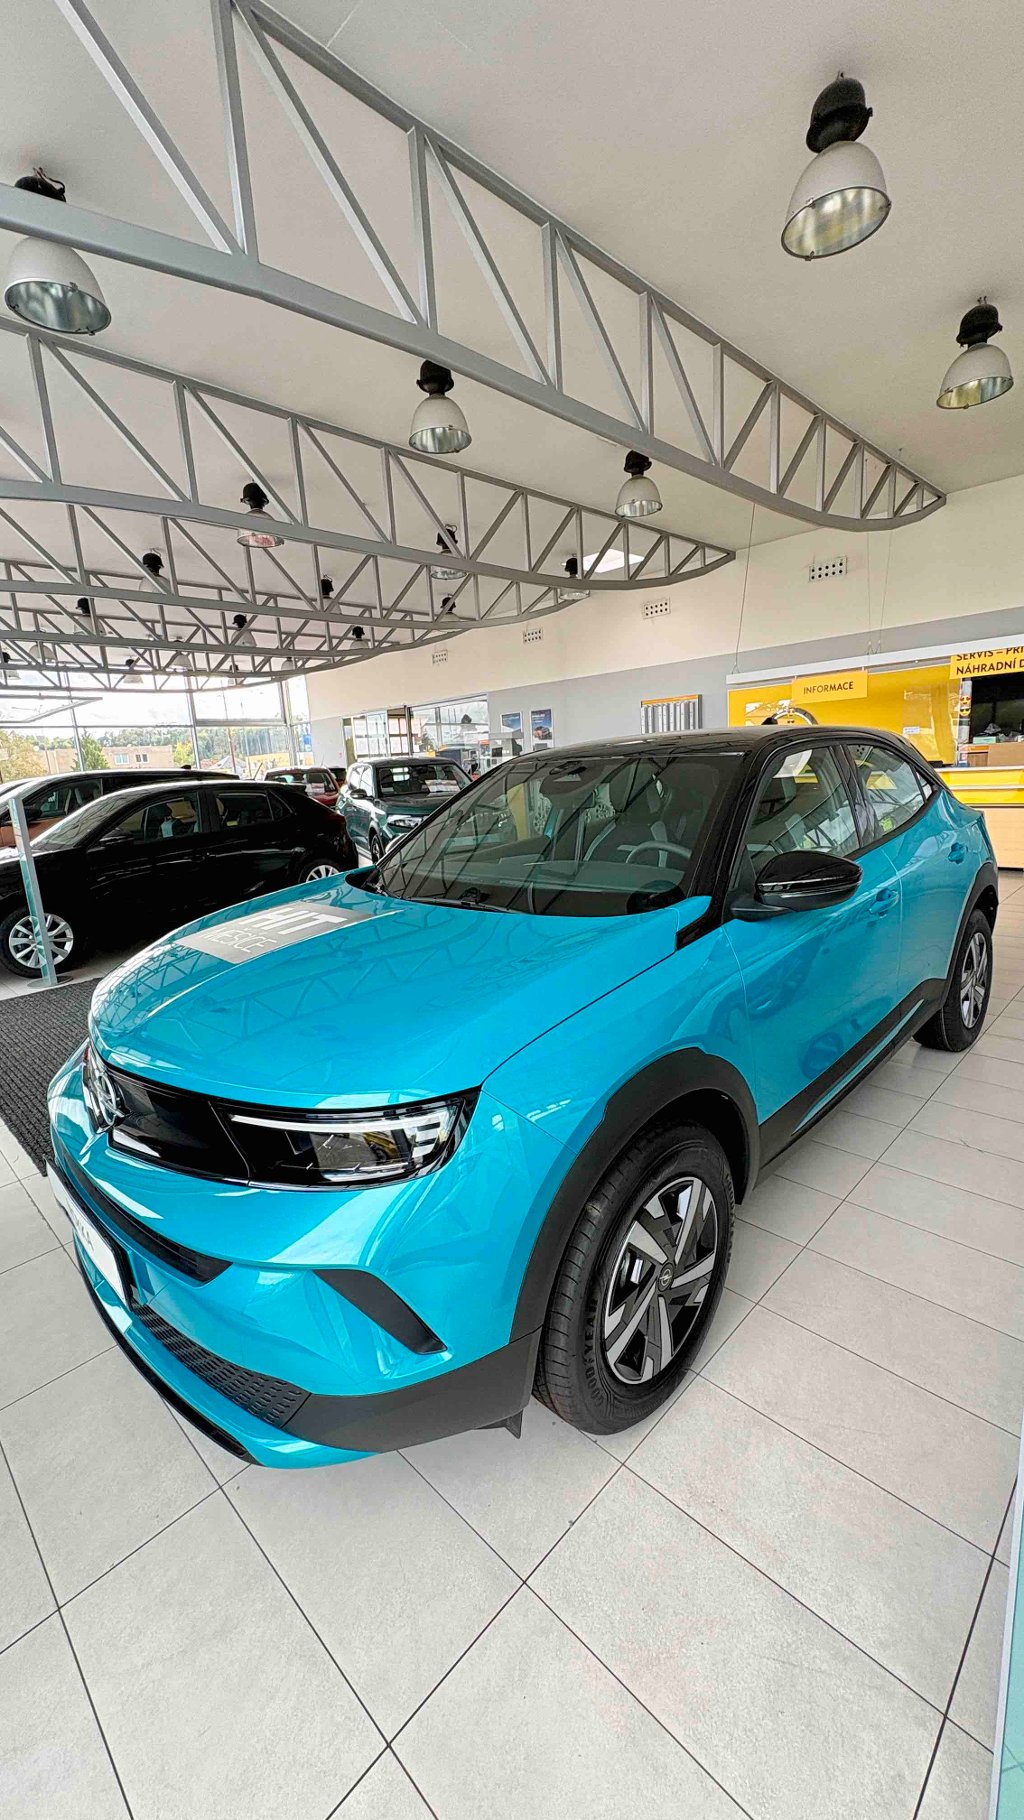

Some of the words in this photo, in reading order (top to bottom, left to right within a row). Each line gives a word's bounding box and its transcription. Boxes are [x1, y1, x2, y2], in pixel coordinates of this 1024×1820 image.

[956, 657, 1017, 675] NÁHRADNÍ
[803, 681, 854, 695] INFORMACE
[238, 907, 348, 935] HIT
